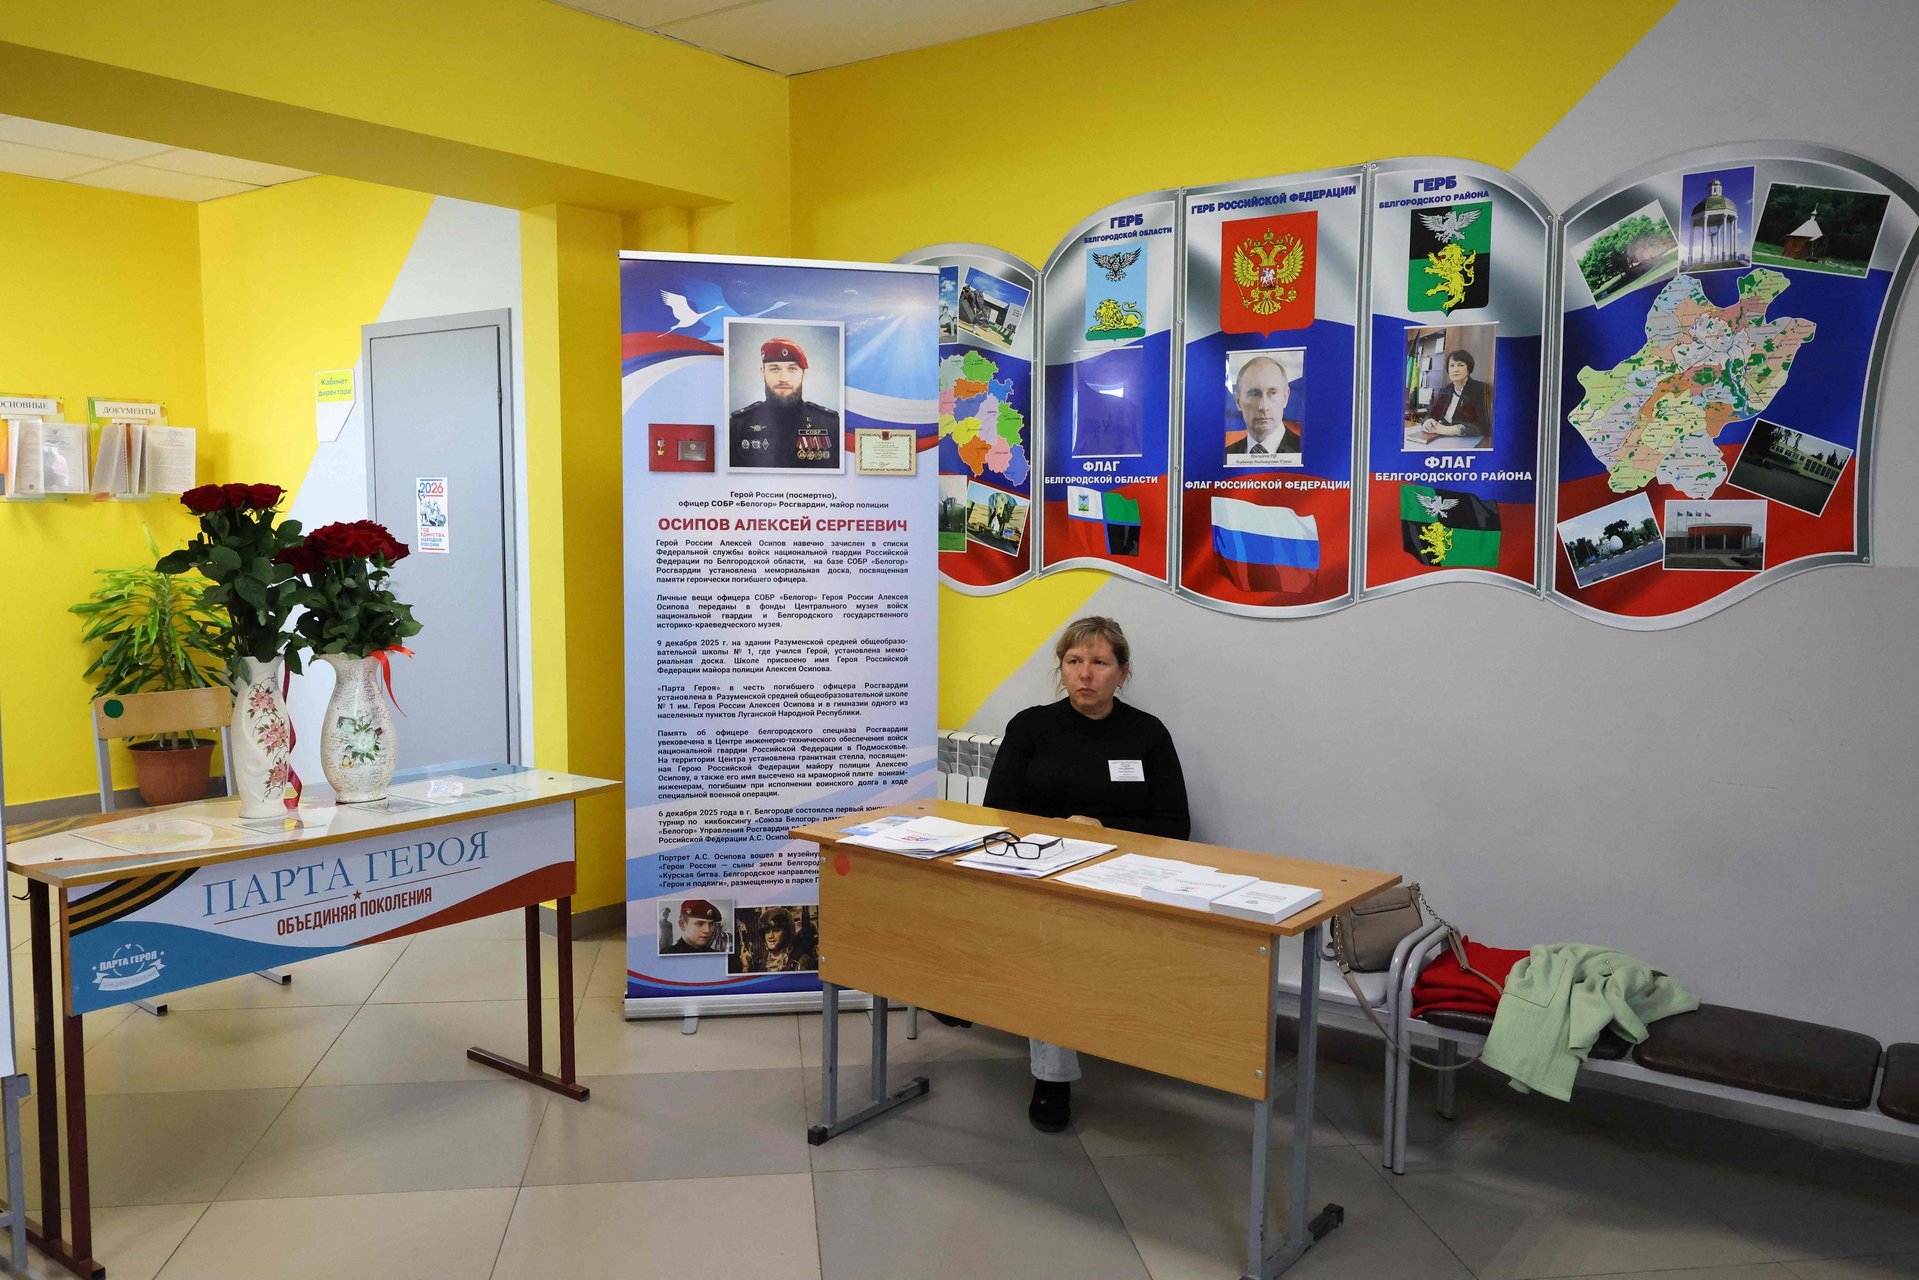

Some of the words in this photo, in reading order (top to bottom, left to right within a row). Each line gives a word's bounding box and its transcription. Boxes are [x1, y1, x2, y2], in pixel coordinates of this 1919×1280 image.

[1413, 175, 1457, 193] ГЕРБ
[1191, 203, 1215, 215] ГЕРБ
[1218, 192, 1287, 211] РОССИЙСКОЙ
[1289, 185, 1357, 203] ФЕДЕРАЦИИ
[1379, 195, 1451, 209] БЕЛГОРОДСКОГО
[1453, 190, 1489, 201] РАЙОНА
[1110, 213, 1144, 229] ГЕРБ
[1083, 230, 1138, 244] БЕЛГОРОДСКОЙ
[1139, 226, 1173, 237] ОБЛАСТИ
[321, 377, 348, 386] Кабинет
[318, 389, 352, 397] директора
[103, 406, 156, 416] ДОКУМЕНТЫ
[1082, 461, 1120, 472] ФЛАГ
[1424, 456, 1476, 469] ФЛАГ
[1045, 475, 1113, 484] БЕЛГОРОДСКОЙ
[1114, 475, 1158, 484] ОБЛАСТИ
[1375, 472, 1477, 483] БЕЛГОРОДСКОГО
[1481, 470, 1532, 481] РАЙОНА
[420, 482, 444, 493] 2026
[1184, 480, 1212, 489] ФЛАГ
[1214, 479, 1282, 489] РОССИЙСКОЙ
[1284, 480, 1350, 490] ФЕДЕРАЦИИ
[755, 490, 783, 498] России
[711, 499, 733, 507] СОБР
[658, 518, 729, 530] ОСИПОВ
[734, 518, 810, 530] АЛЕКСЕЙ
[816, 519, 906, 531] СЕРГЕЕВИЧ
[685, 538, 712, 546] России
[759, 539, 786, 547] Осипов
[656, 548, 708, 556] Федеральной
[712, 548, 743, 556] службы
[774, 548, 827, 556] национальной
[832, 549, 861, 557] гвардии
[866, 548, 908, 556] Российской
[717, 557, 769, 565] Белгородской
[826, 557, 843, 565] базе
[847, 557, 867, 565] СОБР
[709, 567, 756, 575] установлена
[764, 567, 819, 575] мемориальная
[827, 567, 851, 575] доска,
[686, 576, 729, 584] героически
[656, 593, 687, 601] Личные
[692, 594, 712, 602] вещи
[754, 593, 774, 601] СОБР
[878, 592, 908, 600] Алексея
[656, 602, 689, 610] Осипова
[698, 603, 736, 611] переданы
[657, 621, 756, 629] историко-краеведческого
[758, 621, 782, 629] музея.
[657, 658, 692, 666] риальная
[701, 657, 725, 665] доска.
[734, 656, 759, 664] Школе
[767, 657, 806, 665] присвоено
[865, 654, 908, 662] Российской
[732, 666, 763, 674] полиции
[798, 664, 831, 672] Осипова.
[716, 693, 765, 701] Разуменской
[800, 691, 883, 699] общеобразовательной
[705, 711, 735, 719] пунктов
[737, 710, 776, 718] Луганской
[816, 709, 861, 717] Республики.
[887, 733, 907, 741] войск
[717, 747, 747, 755] гвардии
[800, 744, 842, 752] Федерации
[856, 743, 907, 751] Подмосковье.
[658, 783, 703, 791] инженерам,
[750, 782, 763, 790] при
[768, 780, 811, 788] исполнении
[857, 779, 878, 787] долга
[891, 778, 907, 786] ходе
[658, 791, 707, 799] специальной
[709, 790, 740, 798] военной
[658, 819, 684, 827] турнир
[704, 817, 751, 825] кикбоксингу
[786, 815, 819, 823] Белогор»
[202, 857, 353, 918] ПАРТА
[364, 830, 489, 884] ГЕРОЯ
[276, 902, 357, 936] ОБЪЕДИНЯЯ
[360, 886, 433, 917] ПОКОЛЕНИЯ
[99, 957, 129, 971] ПАРТА
[130, 950, 157, 964] ГЕРОЯ
